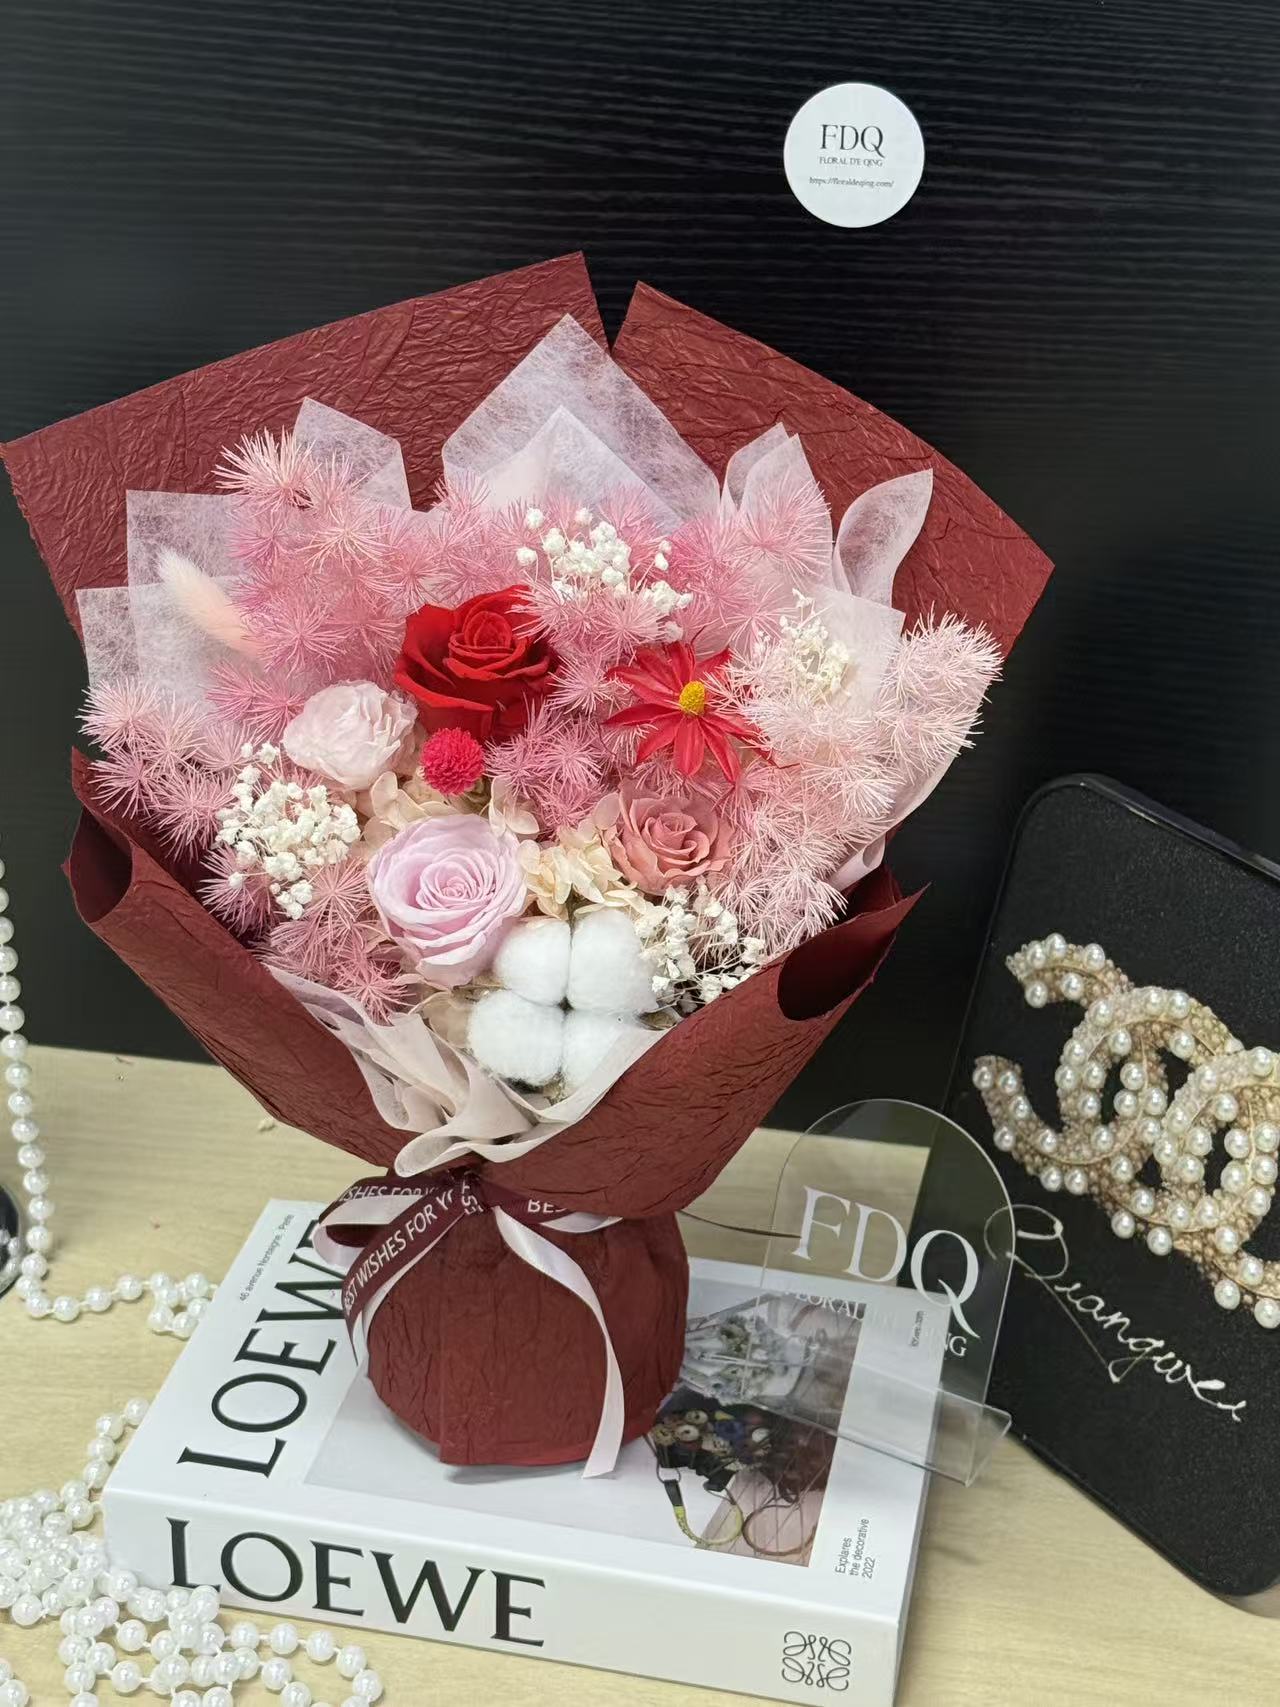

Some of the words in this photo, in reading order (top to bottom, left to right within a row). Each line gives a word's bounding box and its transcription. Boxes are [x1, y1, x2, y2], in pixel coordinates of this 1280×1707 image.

[819, 156, 847, 165] FLORAL
[820, 124, 886, 159] FDQ
[356, 1229, 407, 1288] WISHES
[405, 1204, 438, 1241] FOR
[791, 1185, 980, 1339] FDQ
[176, 1219, 345, 1479] LOEW
[852, 1519, 870, 1560] decorative
[166, 1517, 546, 1647] LOEWE
[849, 1562, 861, 1576] the
[861, 1557, 876, 1579] 2022
